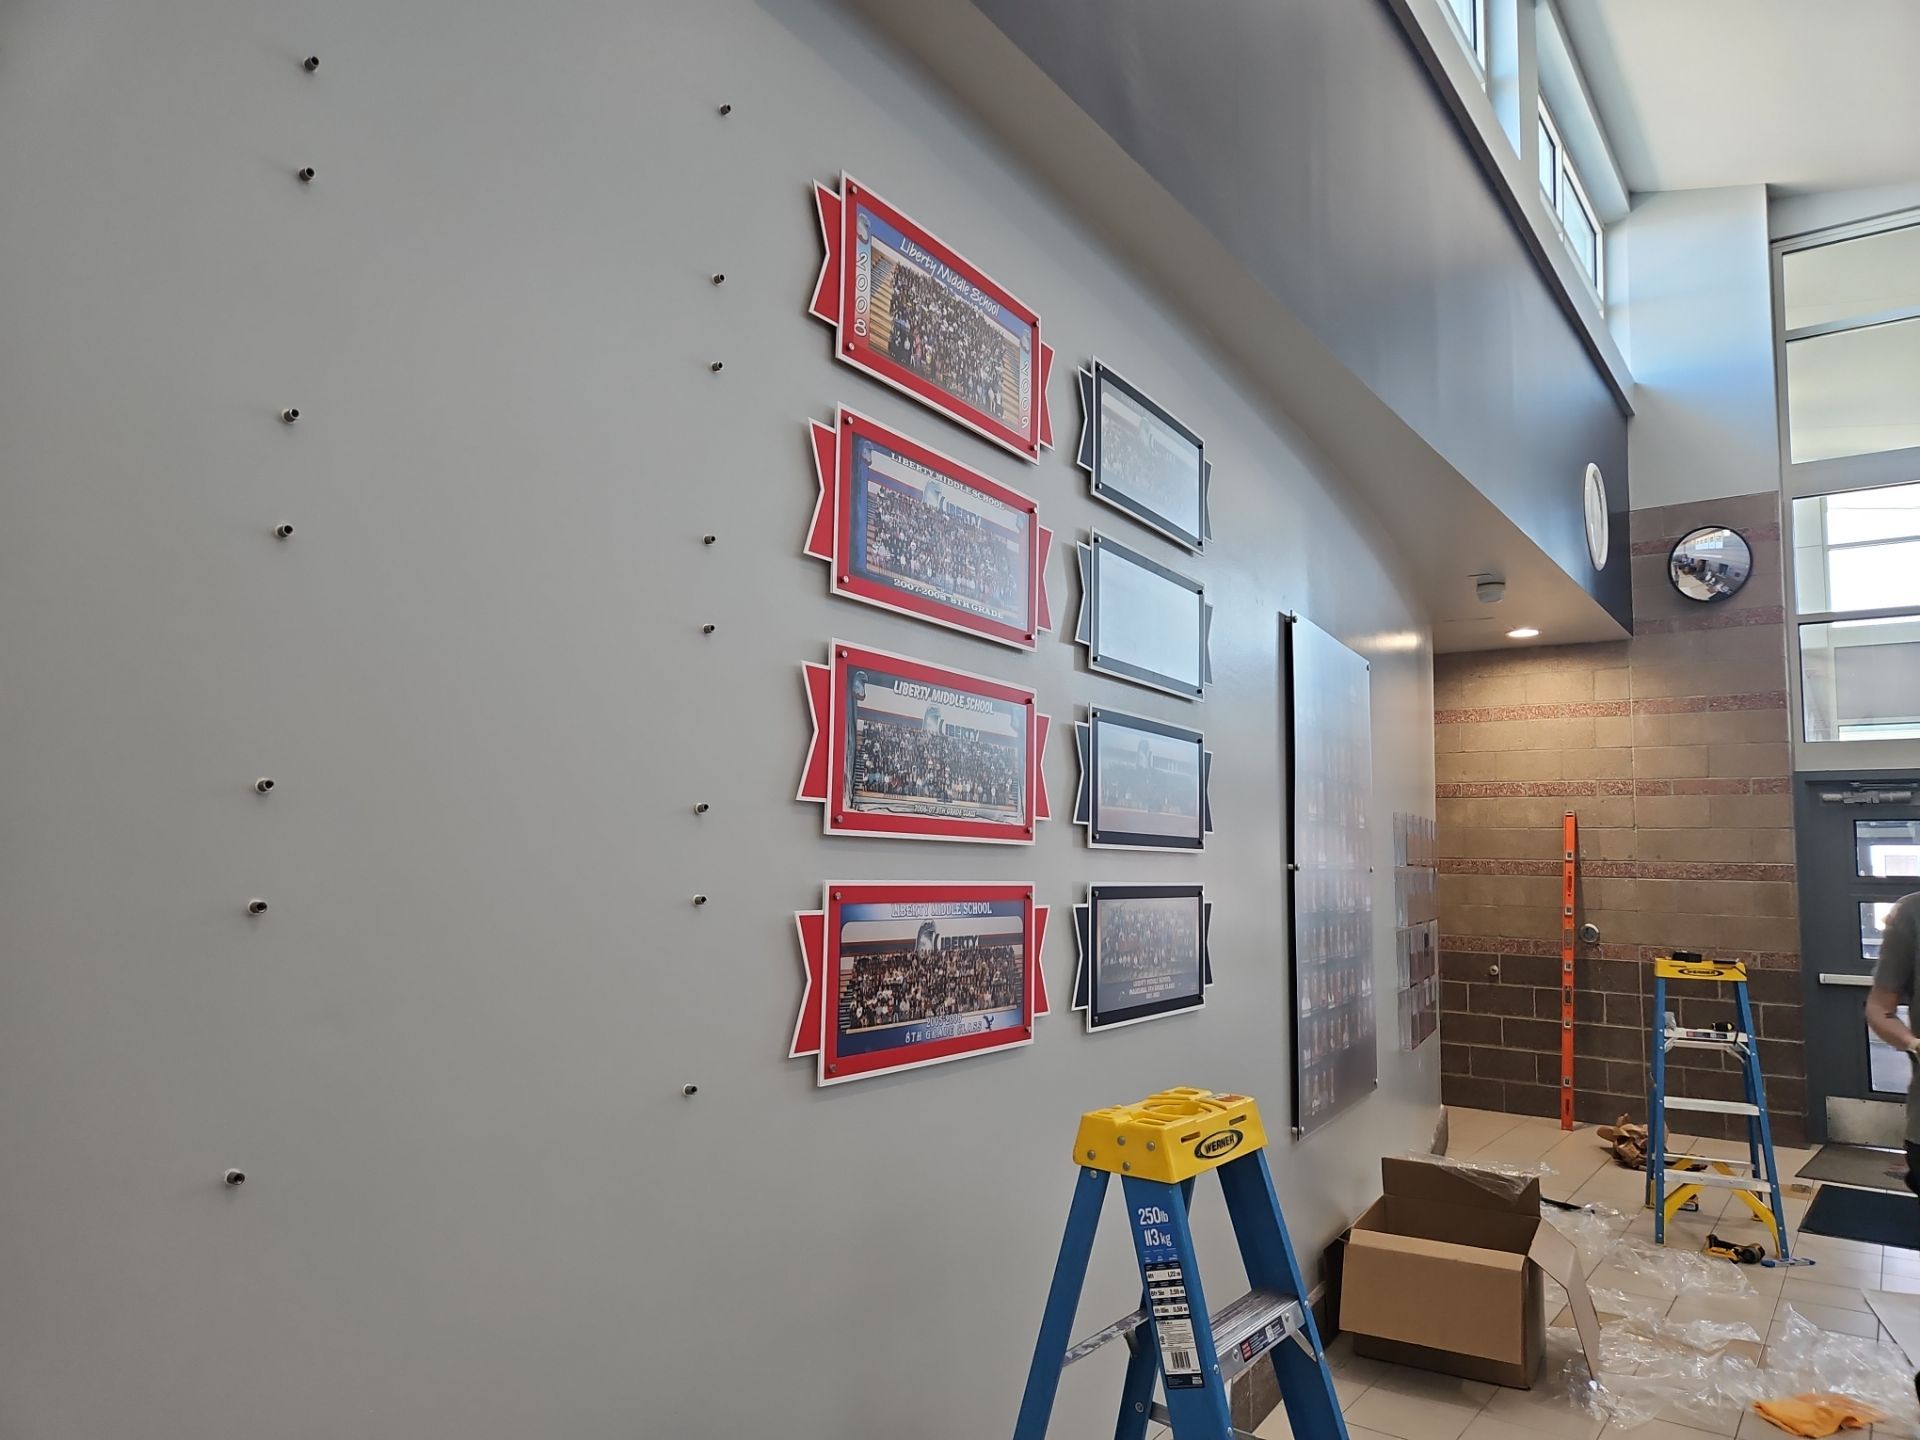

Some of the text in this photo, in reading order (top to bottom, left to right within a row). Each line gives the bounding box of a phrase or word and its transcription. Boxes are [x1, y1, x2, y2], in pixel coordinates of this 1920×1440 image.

[900, 237, 1000, 316] Liberty Middle School
[890, 452, 1006, 510] LIBERTY MIDDLE SCHOOL
[893, 680, 994, 715] LIBERTY MIDDLE SCHOOL
[891, 902, 993, 918] LIBERTY MIDDLE SCHOOL
[1204, 1134, 1234, 1154] WERNER
